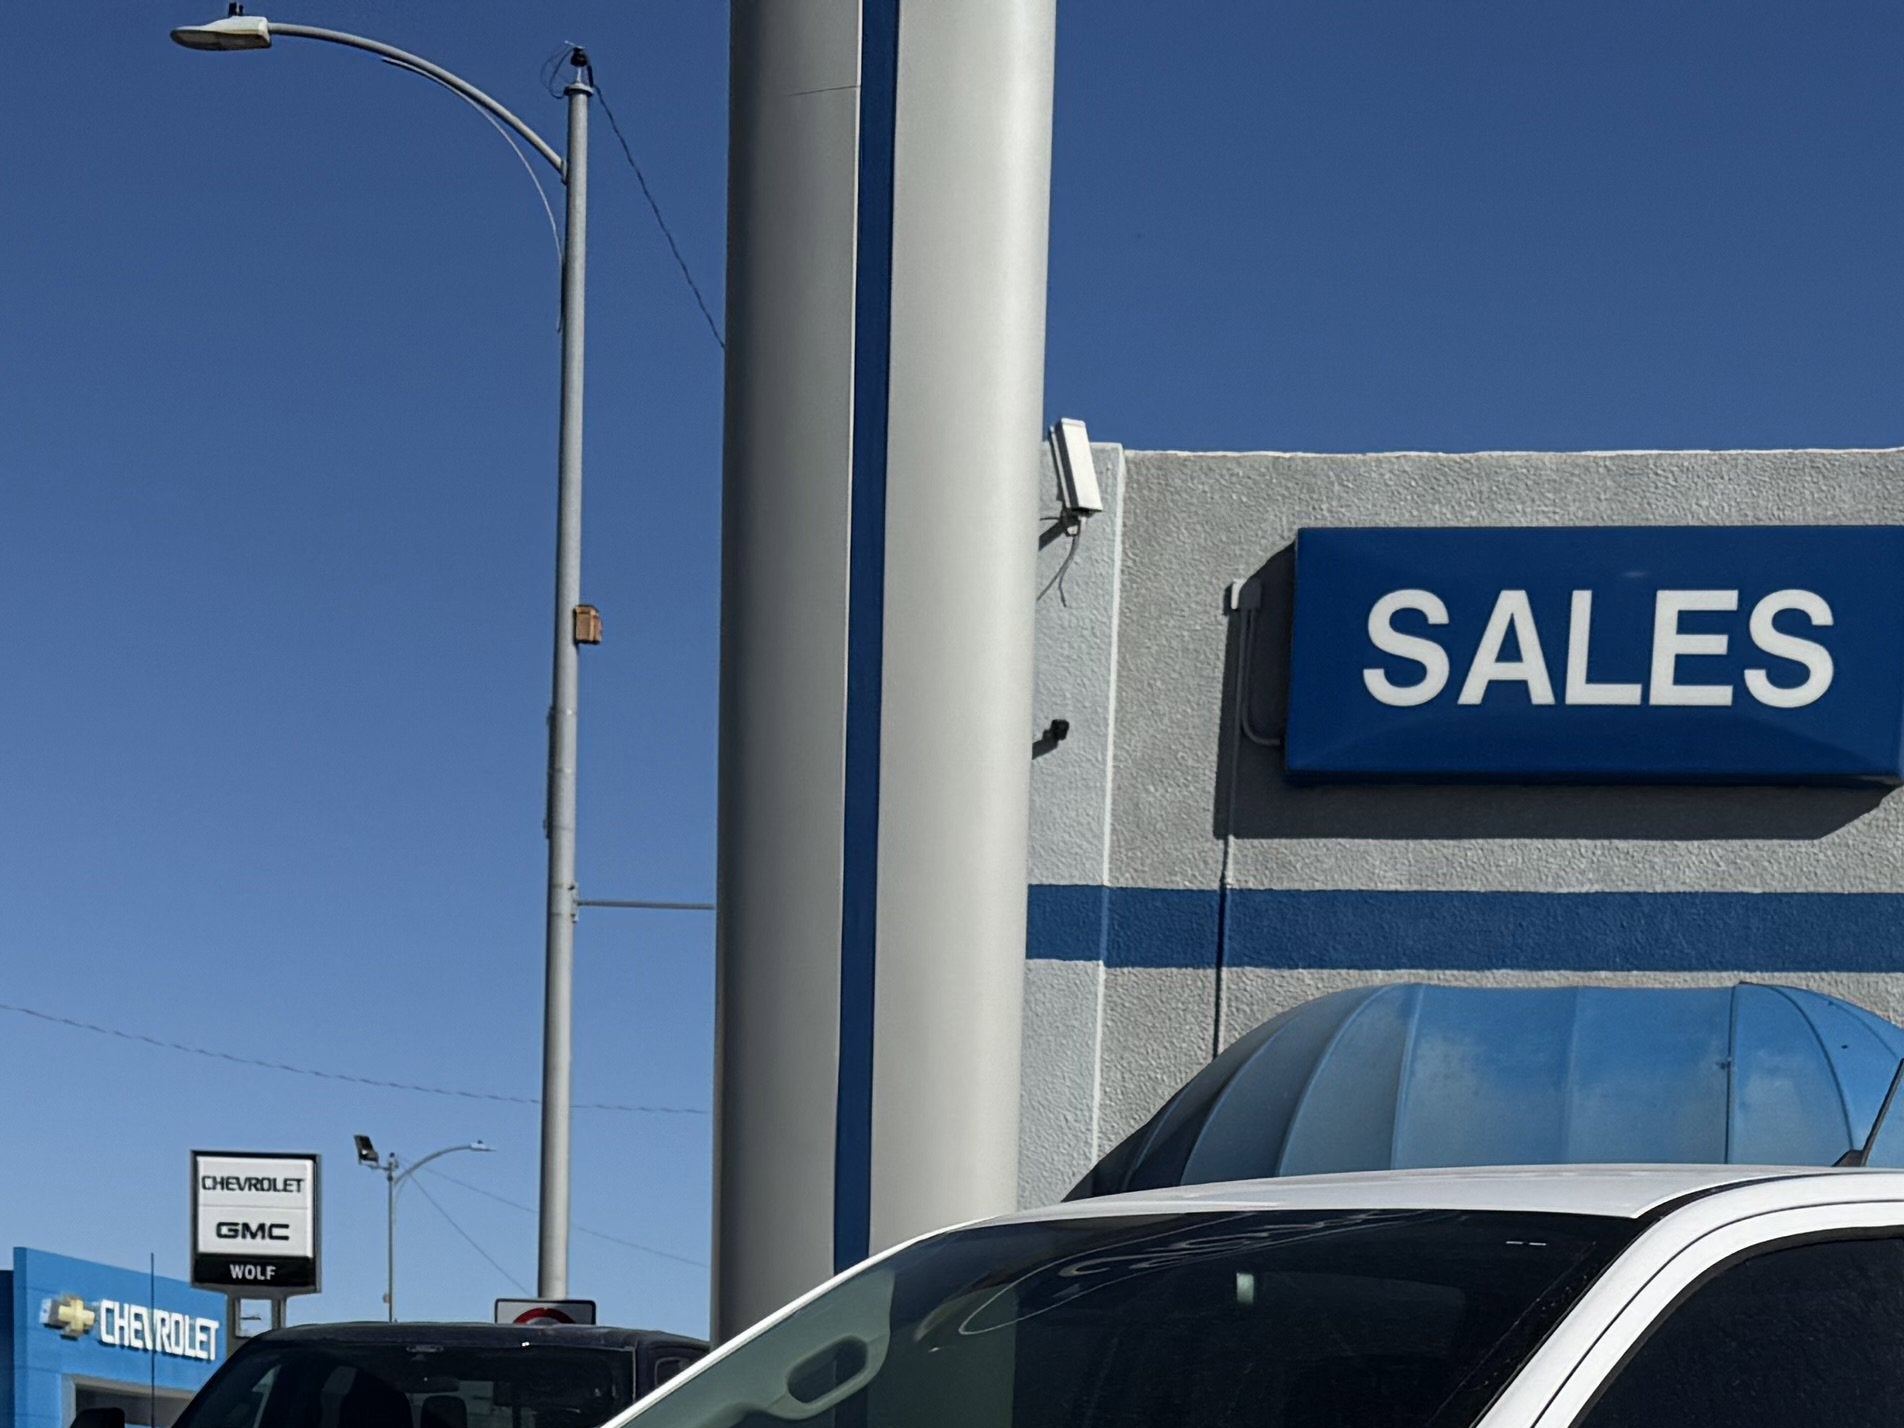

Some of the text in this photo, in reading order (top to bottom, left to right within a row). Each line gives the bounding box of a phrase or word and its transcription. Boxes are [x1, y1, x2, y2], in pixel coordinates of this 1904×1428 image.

[1362, 588, 1835, 708] SALES
[201, 1175, 304, 1193] CHEVROLET
[216, 1221, 290, 1241] GMC
[229, 1264, 276, 1280] WOLF
[100, 1299, 219, 1361] CHEVROLET
